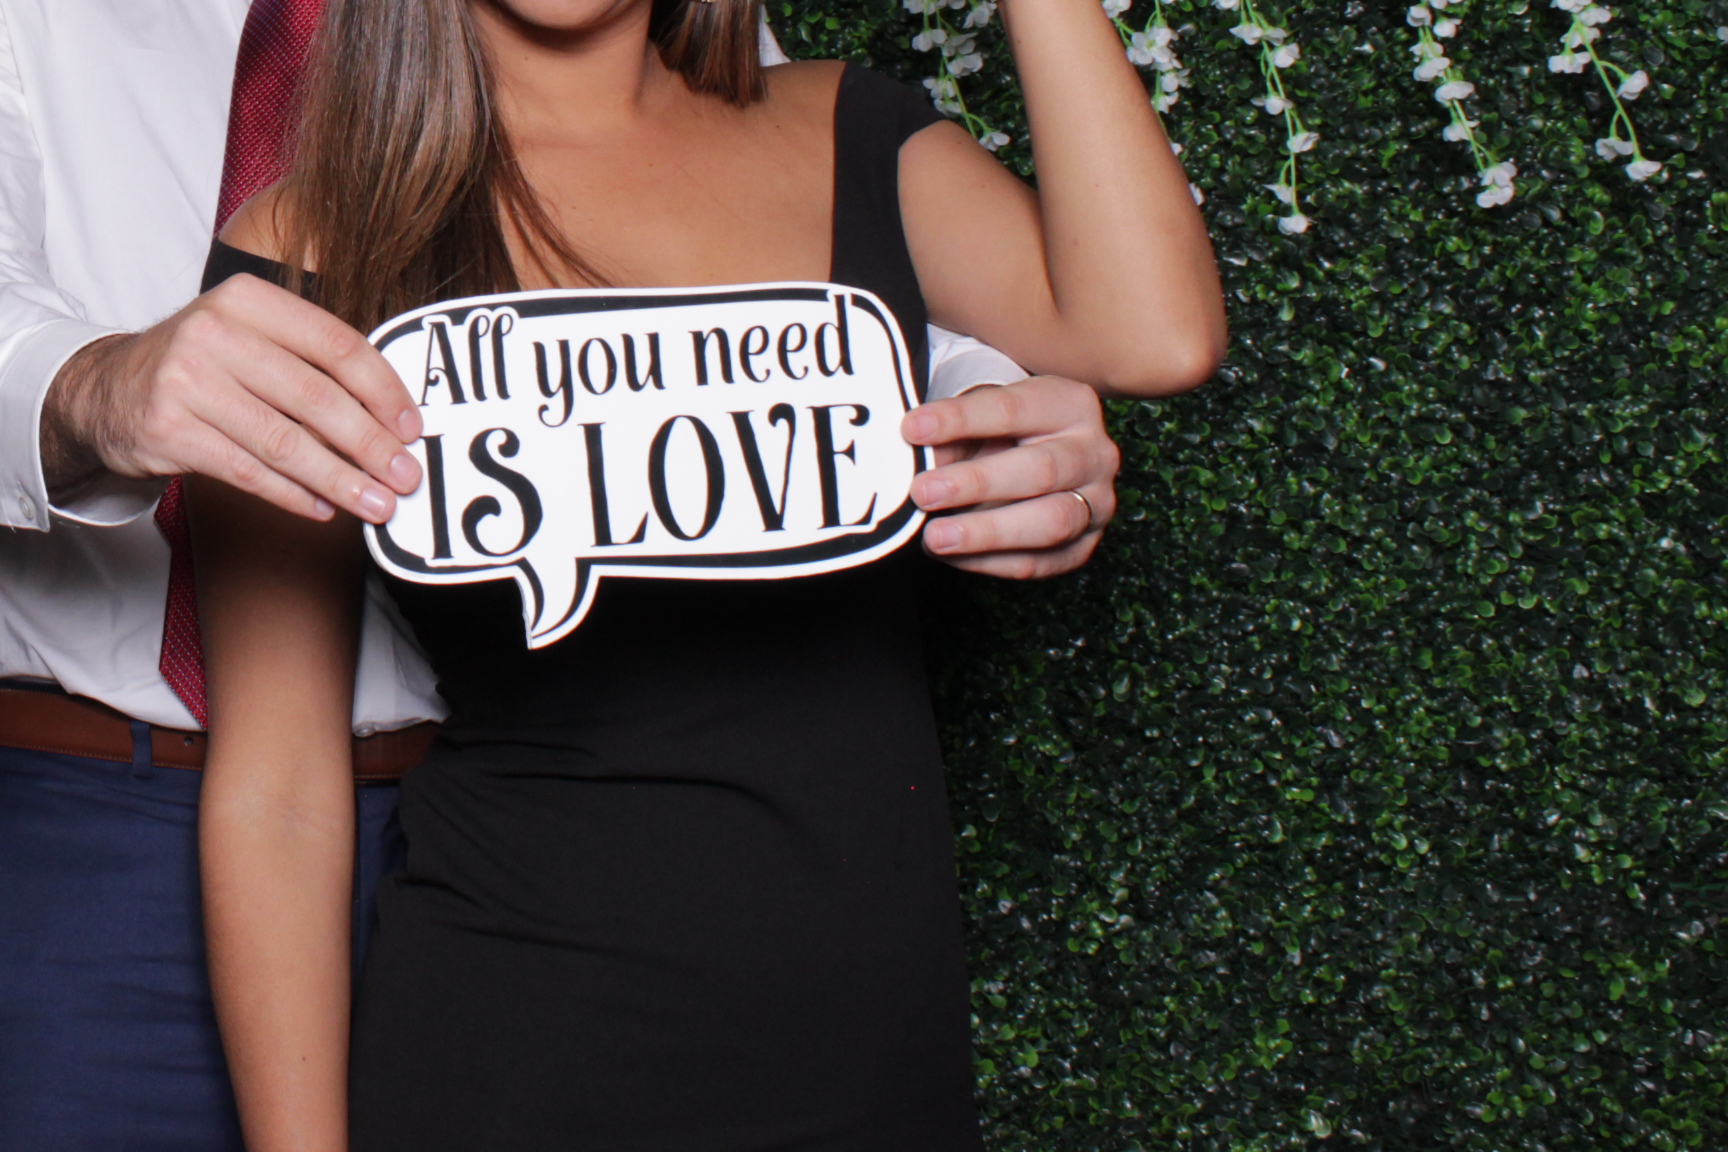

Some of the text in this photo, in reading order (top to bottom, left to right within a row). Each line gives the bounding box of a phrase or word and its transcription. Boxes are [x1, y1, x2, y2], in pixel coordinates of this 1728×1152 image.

[418, 294, 855, 428] All you need
[418, 402, 878, 560] IS LOVE
